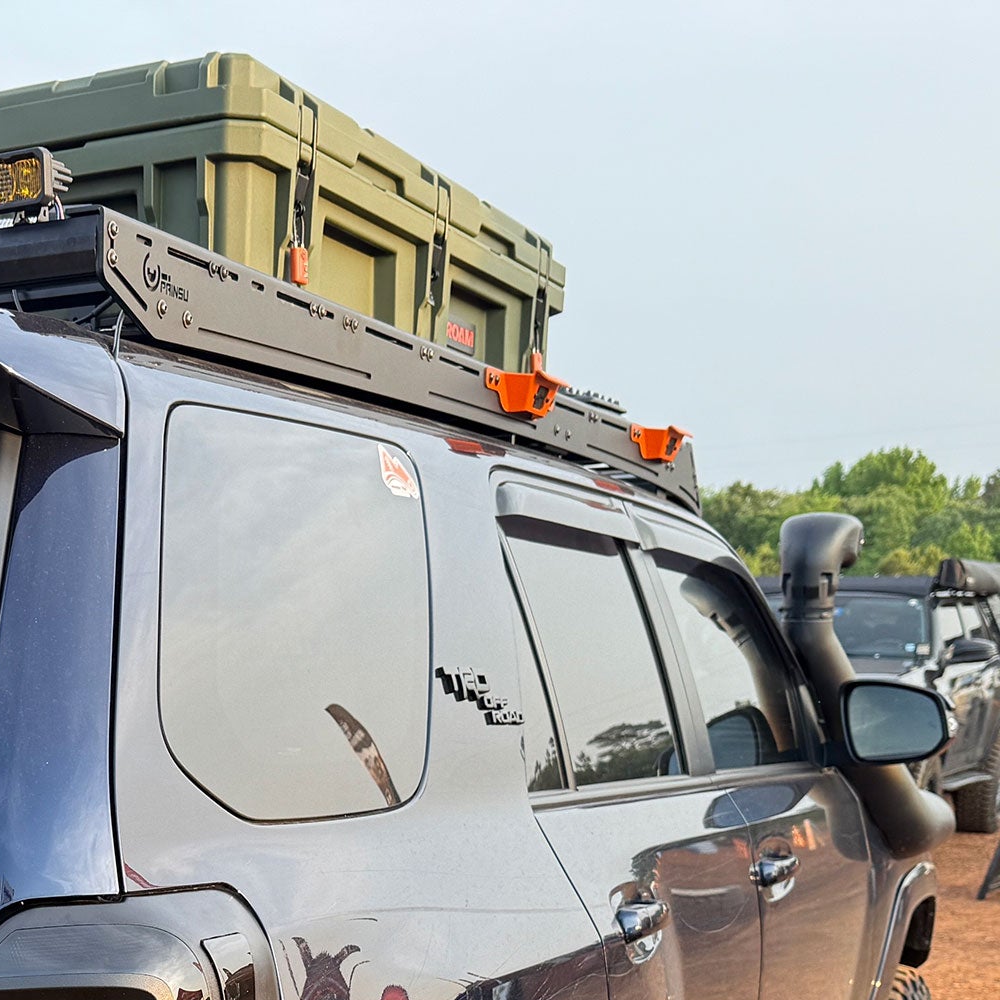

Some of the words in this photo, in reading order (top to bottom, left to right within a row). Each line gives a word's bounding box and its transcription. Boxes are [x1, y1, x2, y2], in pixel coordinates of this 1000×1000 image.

[160, 281, 190, 302] PRINSU
[446, 321, 475, 348] ROAM
[485, 711, 525, 725] ROAD
